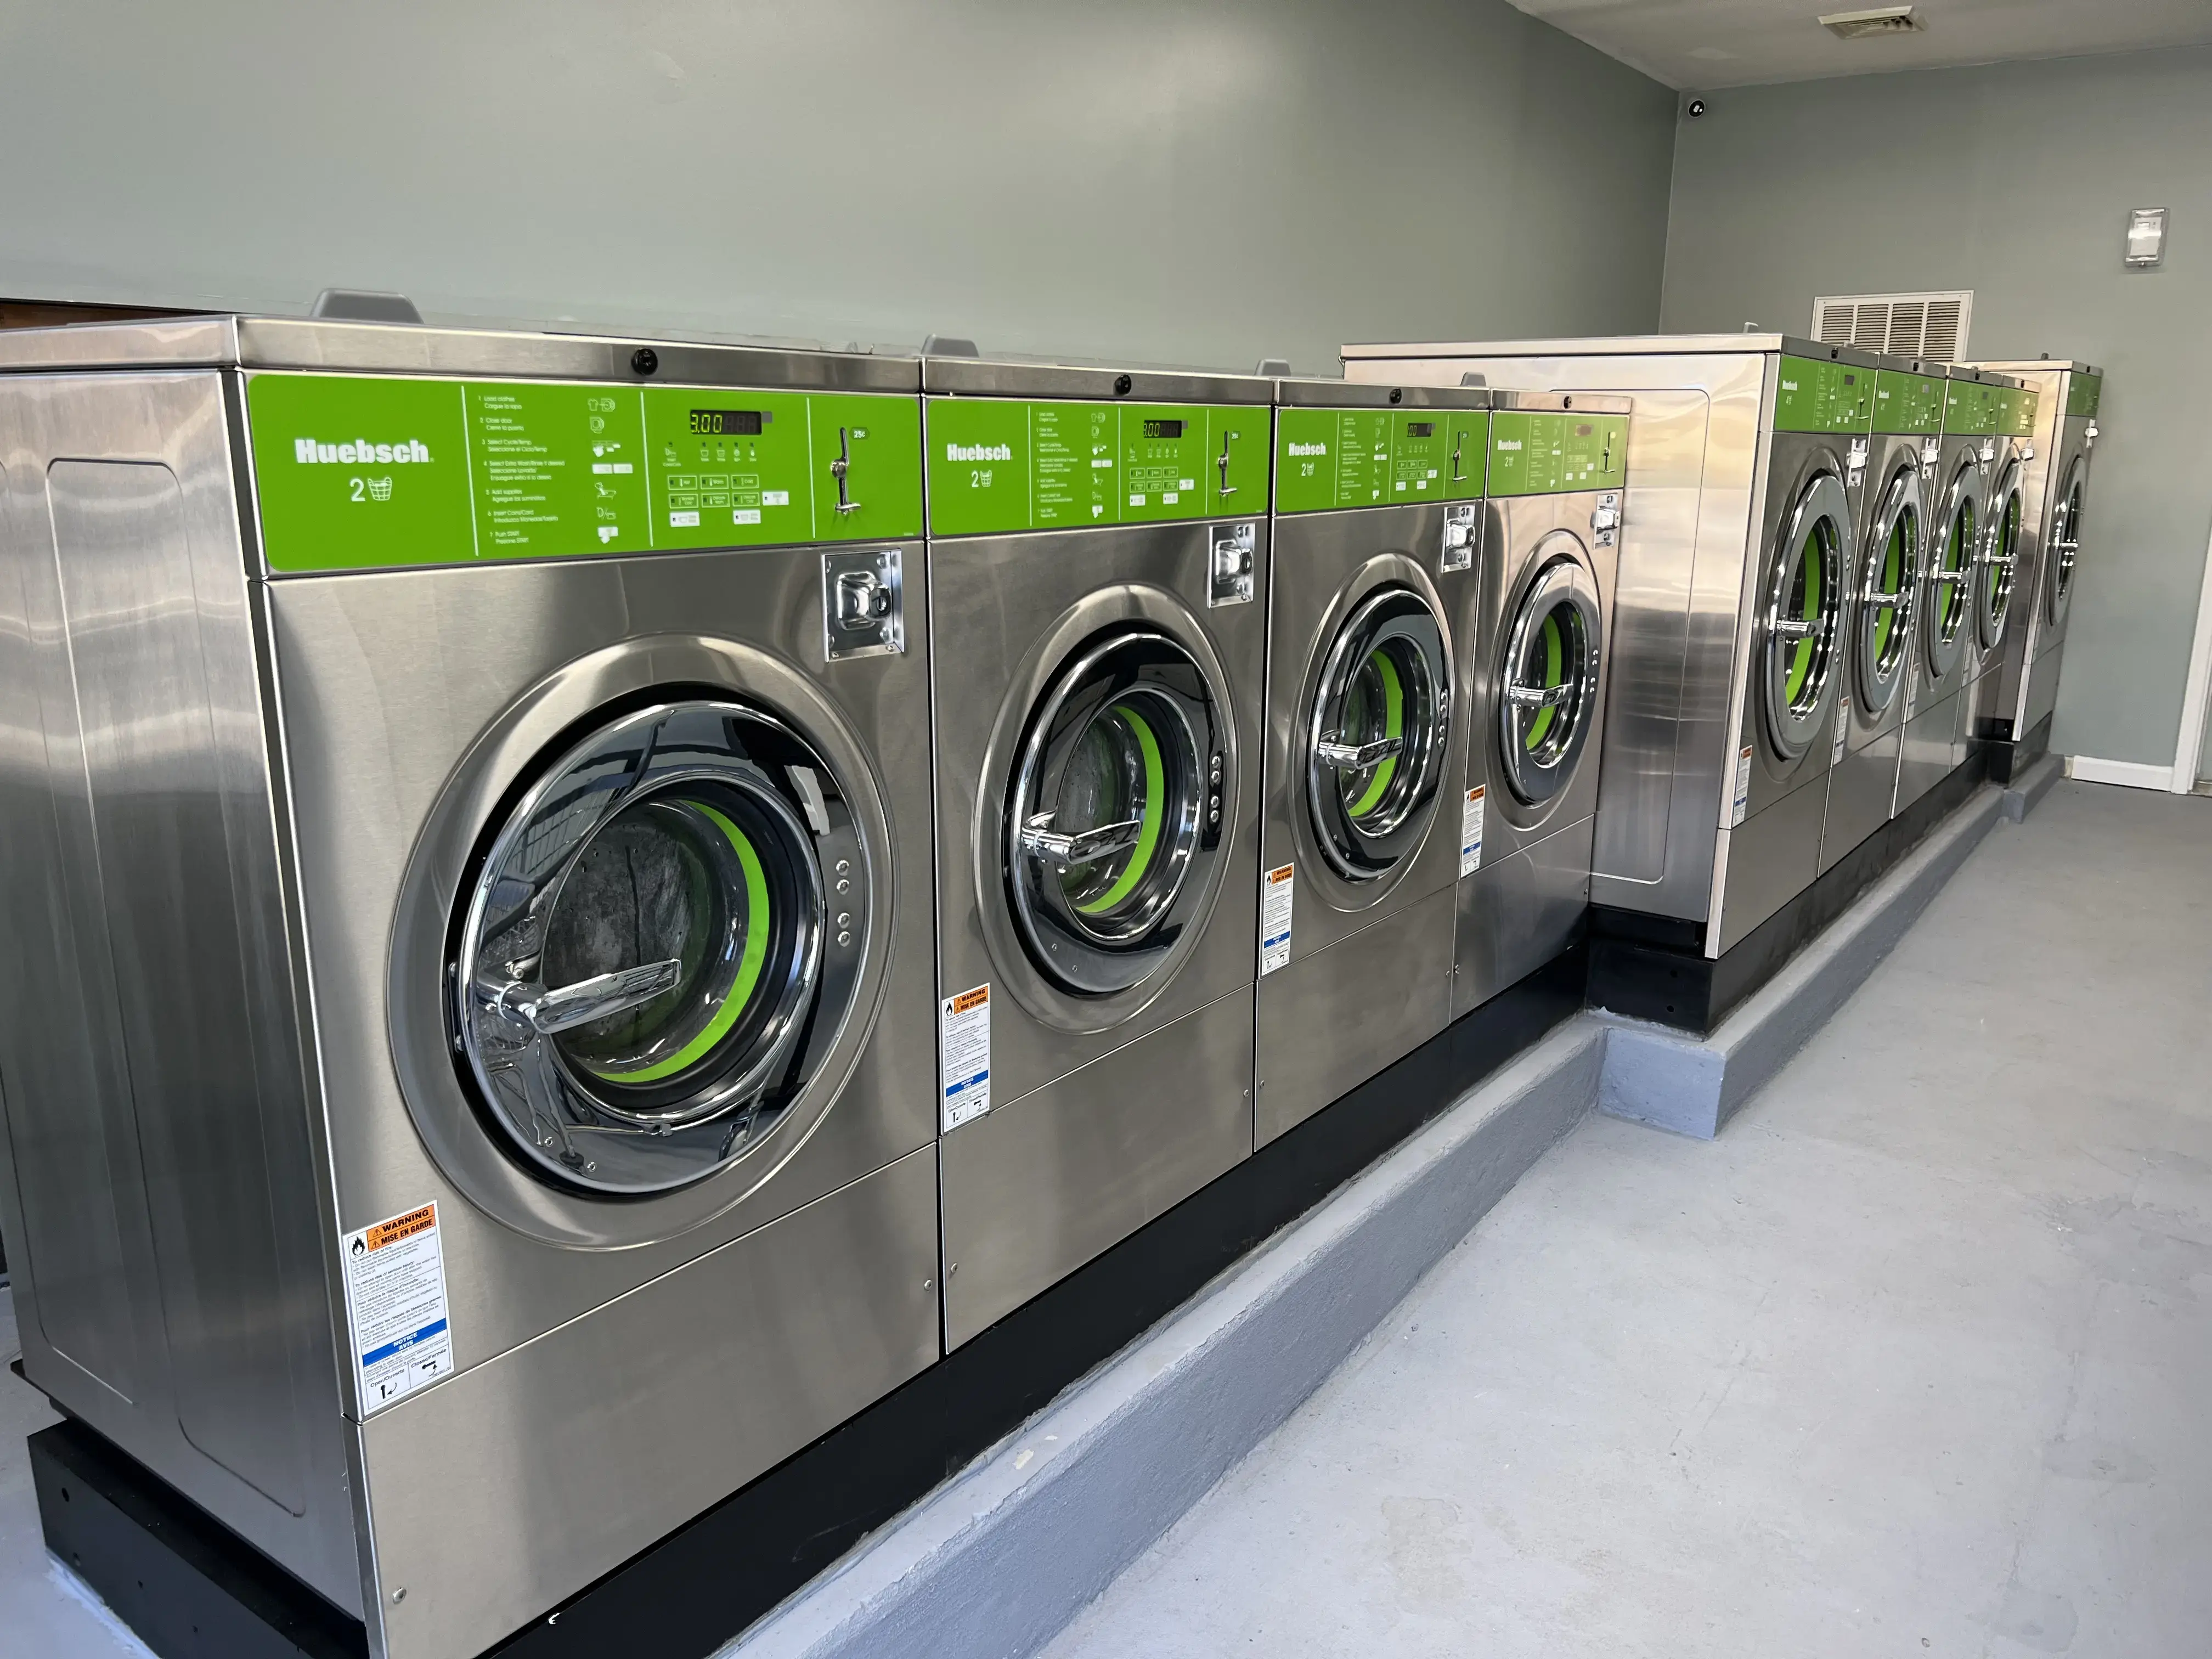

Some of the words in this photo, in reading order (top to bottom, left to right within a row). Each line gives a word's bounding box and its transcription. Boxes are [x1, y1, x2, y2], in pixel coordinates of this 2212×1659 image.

[691, 414, 723, 433] 3.00
[295, 439, 428, 464] Huebsch
[947, 443, 1011, 461] Huebsch
[1289, 442, 1326, 456] Huebsch
[1301, 463, 1306, 476] 2
[971, 471, 979, 487] 2
[350, 478, 365, 501] 2
[962, 989, 985, 1002] WARNING
[382, 1209, 428, 1233] WARNING
[381, 1232, 398, 1245] MISE
[400, 1228, 409, 1237] EN
[410, 1218, 433, 1233] GARDE
[393, 1331, 417, 1347] NOTICE
[398, 1339, 413, 1351] AVIS
[370, 1368, 404, 1389] Open/Ouverte
